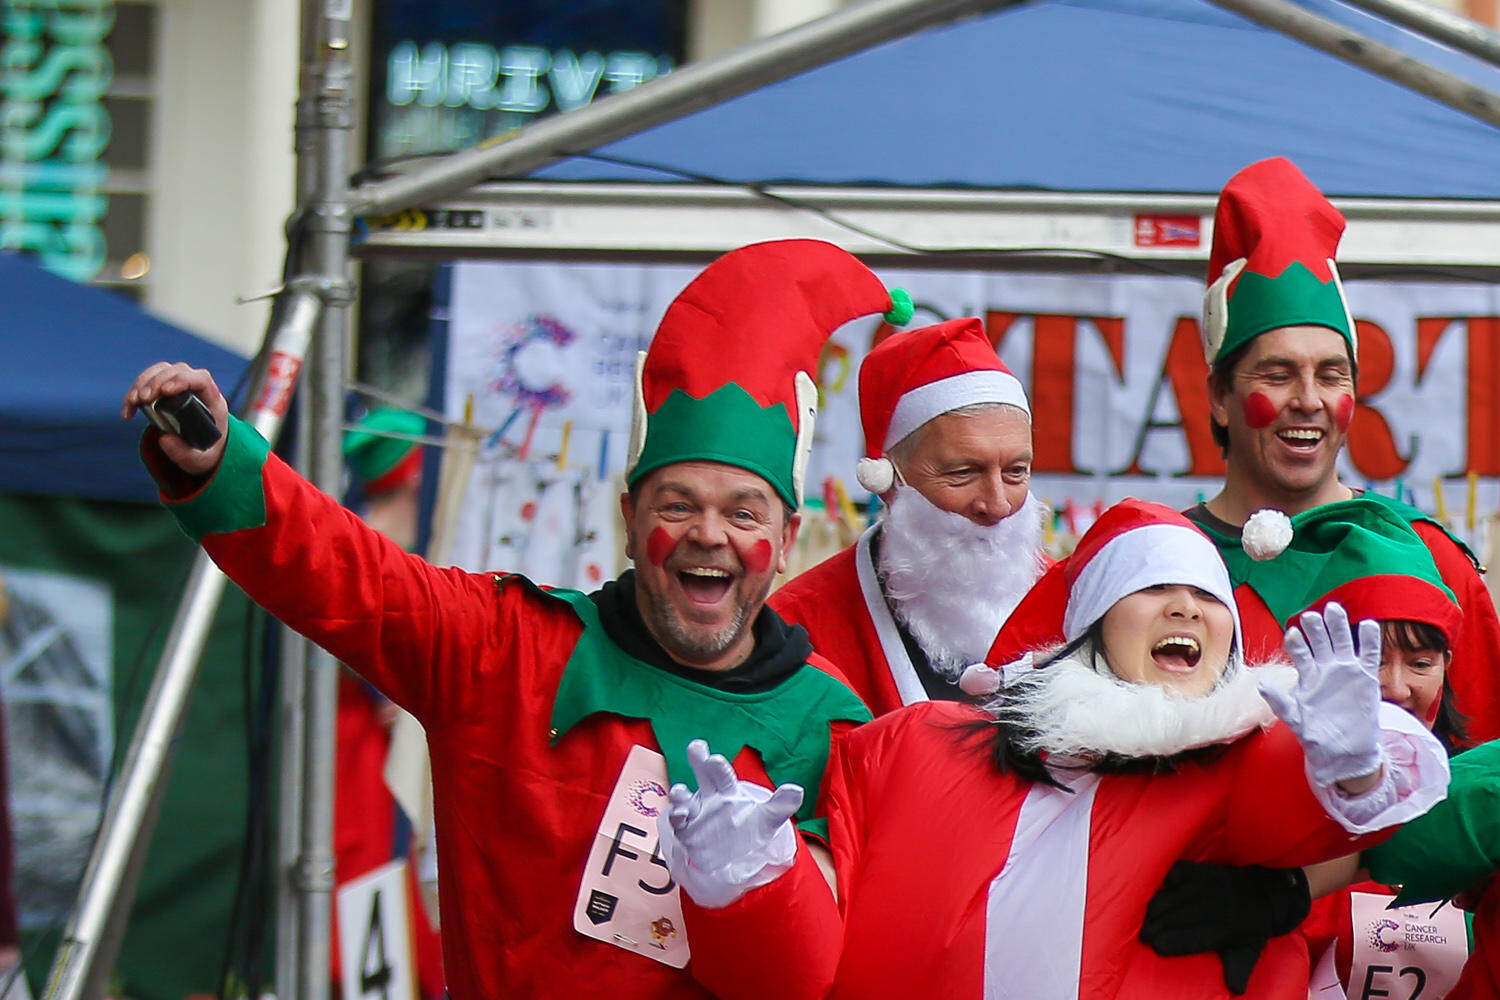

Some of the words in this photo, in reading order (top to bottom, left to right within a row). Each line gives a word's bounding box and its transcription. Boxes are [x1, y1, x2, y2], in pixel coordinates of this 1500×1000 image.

[602, 822, 675, 895] F5
[1404, 923, 1438, 935] CANCER
[1405, 933, 1447, 945] RESEARCH
